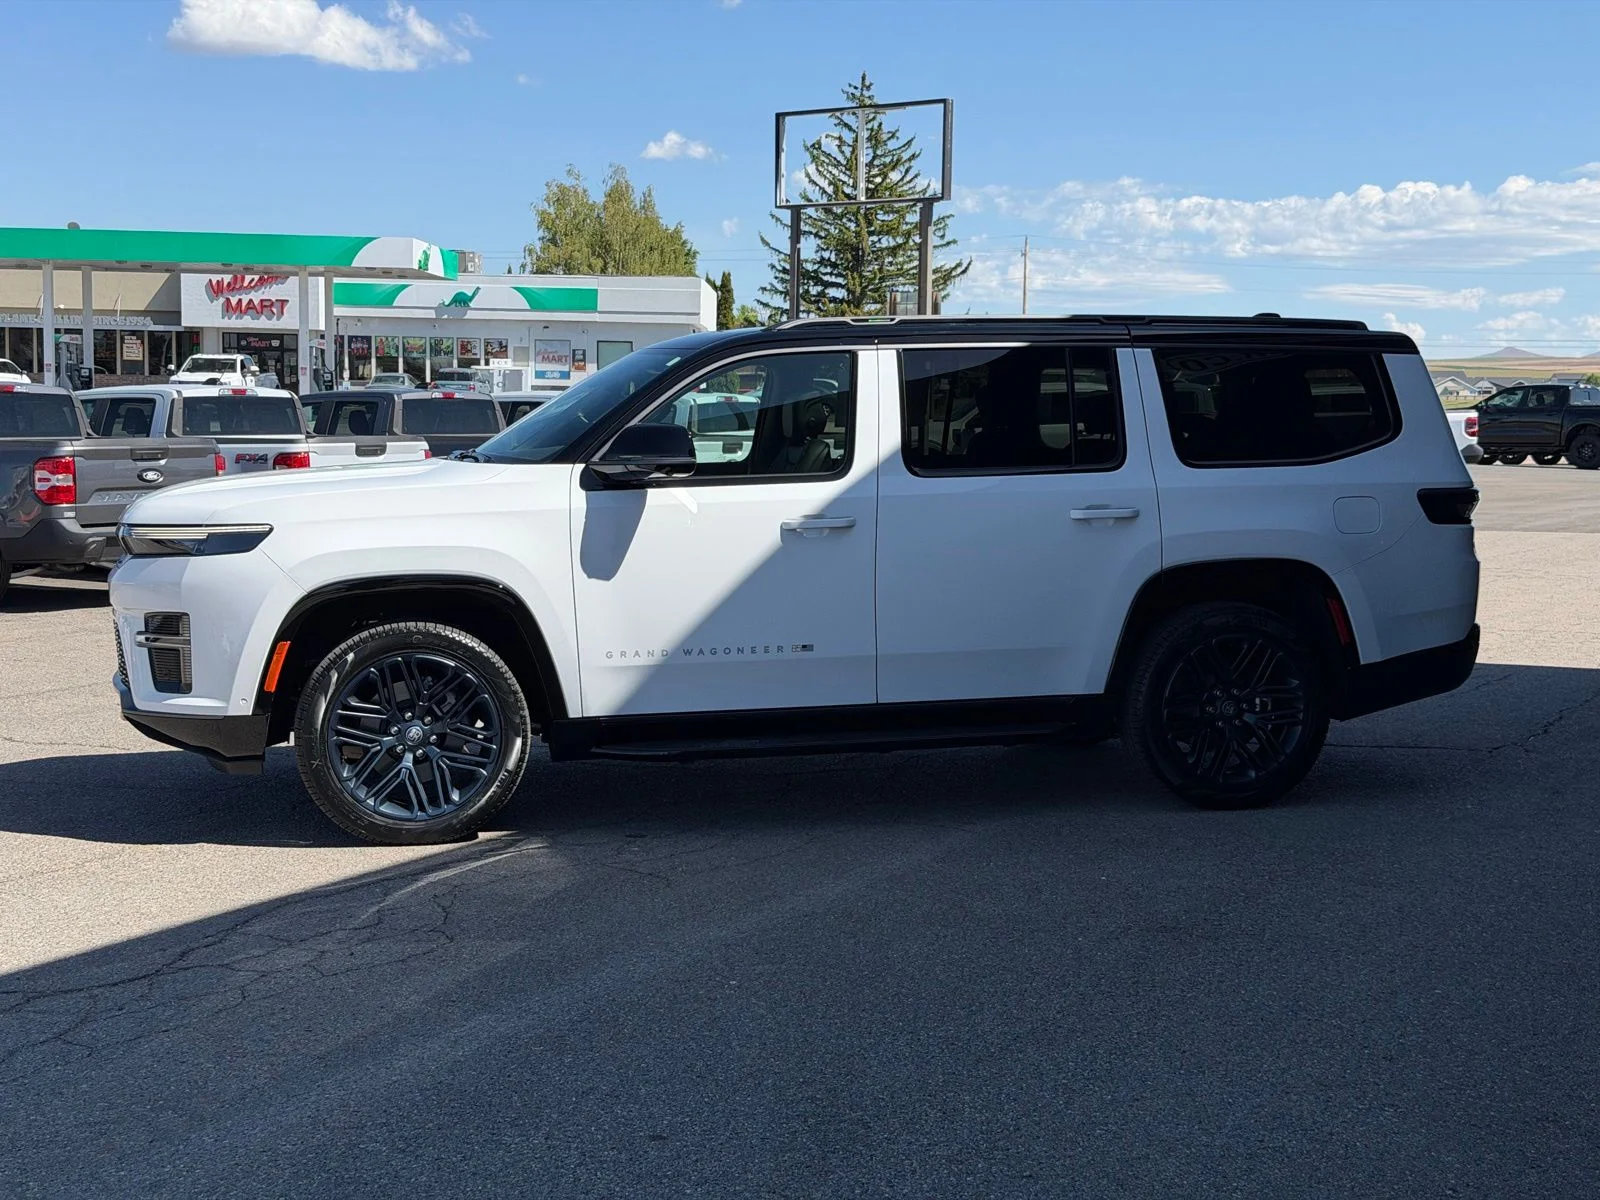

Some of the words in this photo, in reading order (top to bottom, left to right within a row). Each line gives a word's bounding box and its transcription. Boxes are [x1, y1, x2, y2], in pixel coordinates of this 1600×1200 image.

[225, 297, 290, 316] MART
[541, 354, 569, 364] MART
[234, 452, 268, 465] FX4
[605, 648, 669, 660] GRAND
[682, 645, 785, 657] WAGONEER
